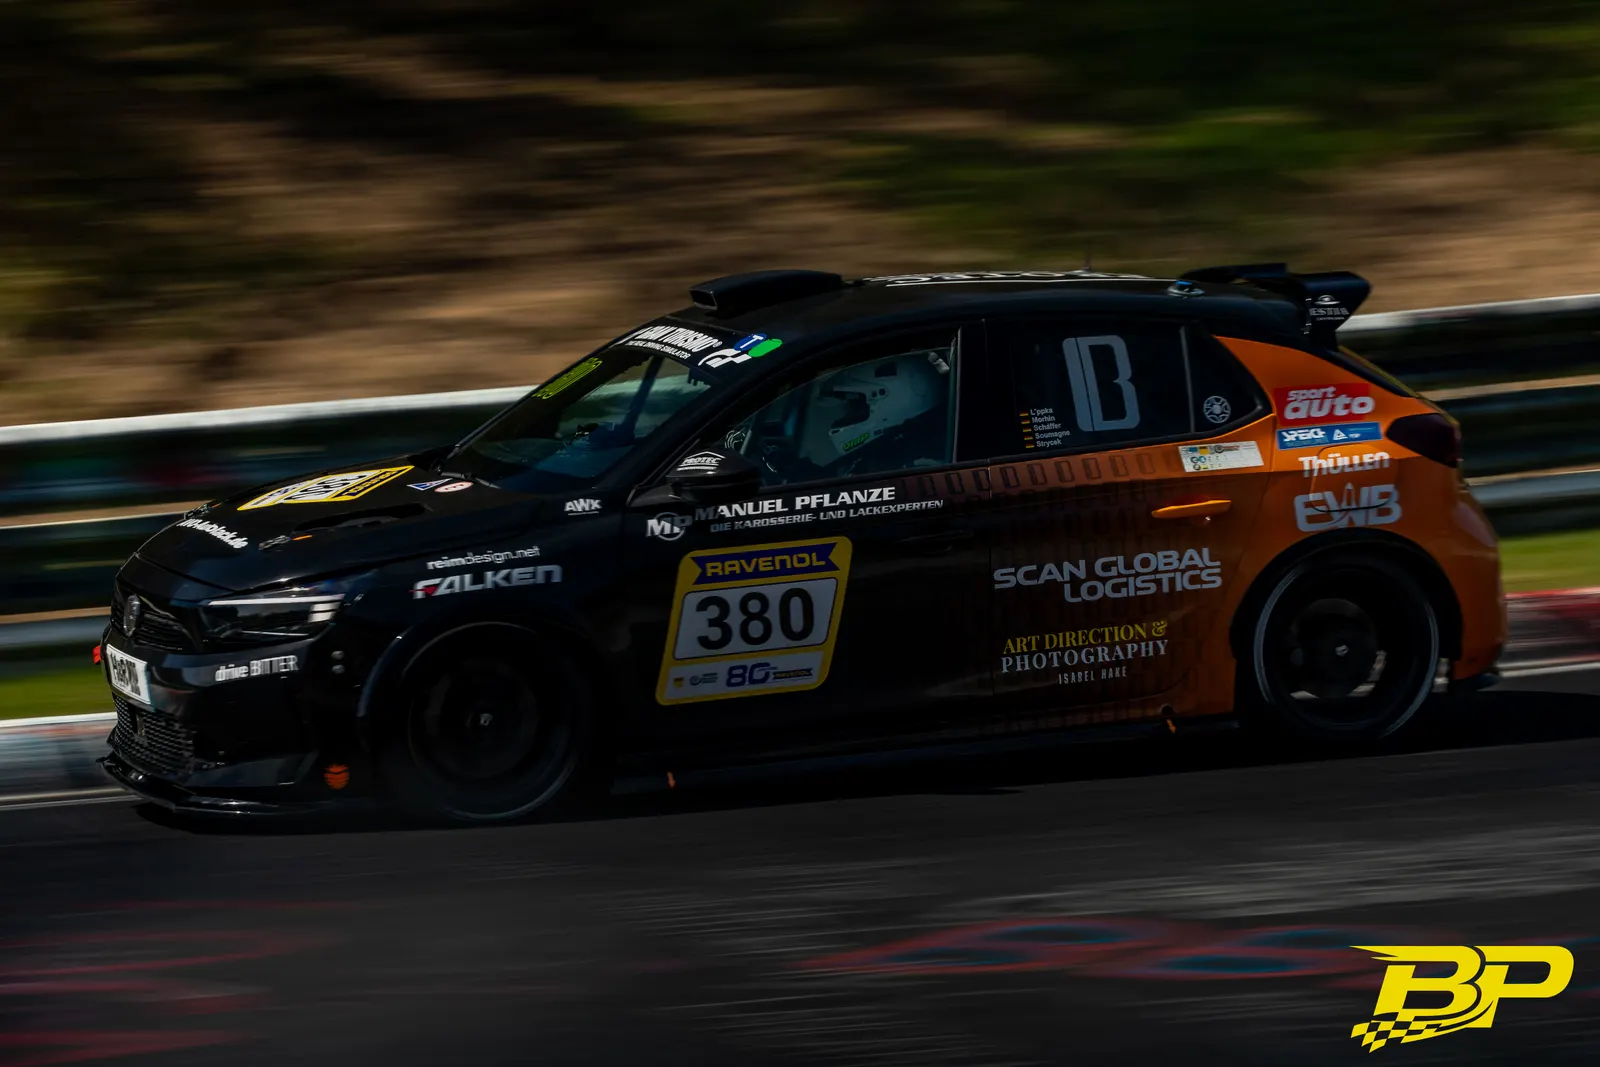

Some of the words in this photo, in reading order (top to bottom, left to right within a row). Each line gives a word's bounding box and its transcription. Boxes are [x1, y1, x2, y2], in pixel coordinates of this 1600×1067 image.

[1283, 395, 1376, 421] auto
[1286, 386, 1337, 401] sport
[695, 498, 789, 520] MANUEL
[794, 486, 896, 510] PFLANZE
[710, 521, 732, 533] DIE
[733, 512, 818, 530] KAROSSERIE-
[820, 509, 846, 521] UND
[849, 499, 944, 518] LACKEXPERTEN
[426, 545, 541, 570] reimdesign.net
[705, 551, 827, 578] RAVENOL
[993, 559, 1087, 591] SCAN
[1094, 547, 1222, 578] GLOBAL
[412, 564, 564, 600] FALKEN
[1064, 567, 1223, 603] LOGISTICS
[695, 587, 815, 651] 380
[1003, 634, 1040, 655] ART
[1044, 622, 1148, 650] DIRECTION
[1151, 619, 1169, 637] &
[1001, 639, 1169, 674] PHOTOGRAPHY
[1058, 670, 1095, 685] ISABEL
[1101, 665, 1128, 680] HAKE
